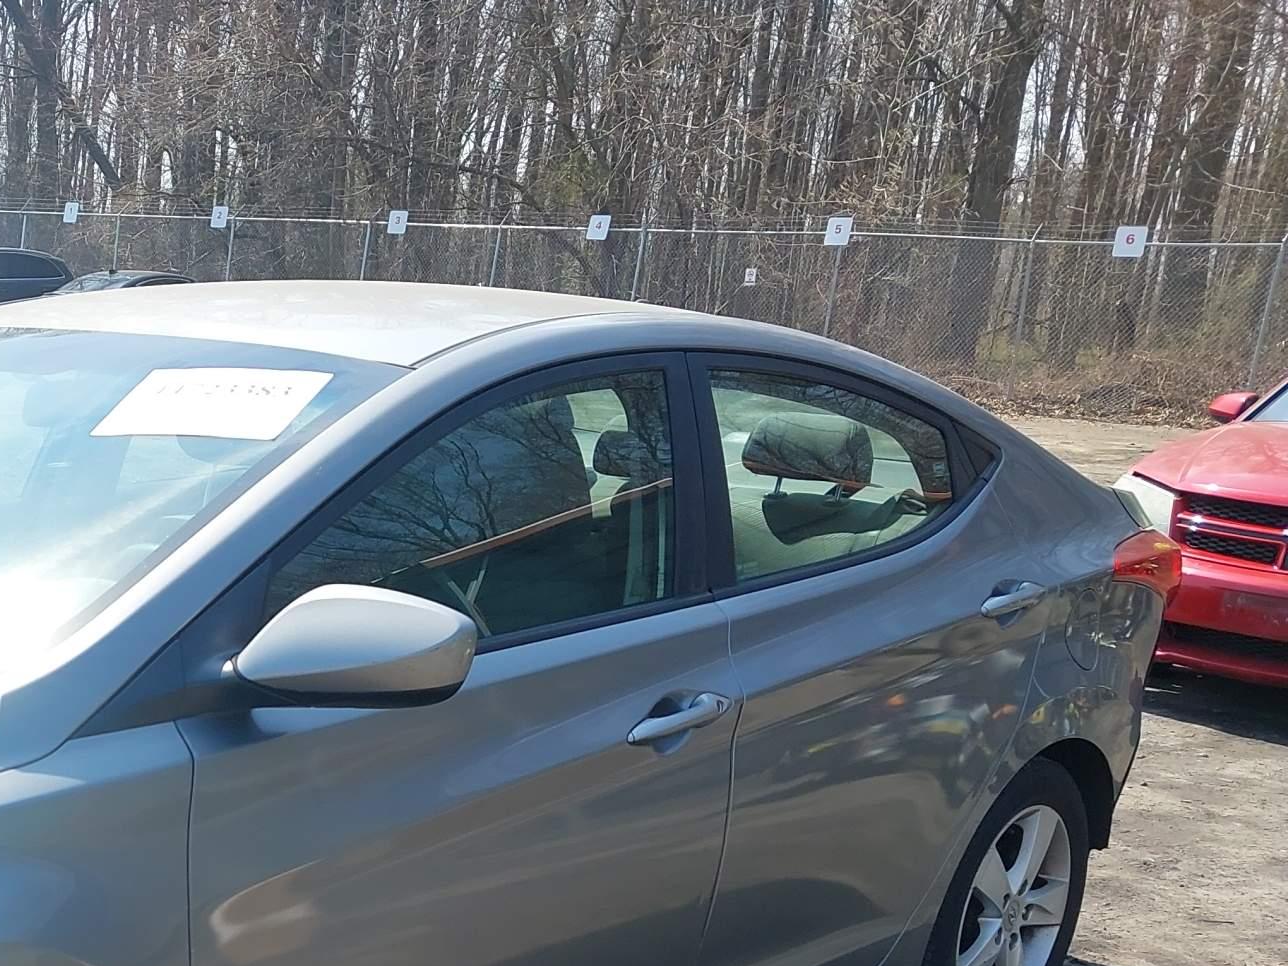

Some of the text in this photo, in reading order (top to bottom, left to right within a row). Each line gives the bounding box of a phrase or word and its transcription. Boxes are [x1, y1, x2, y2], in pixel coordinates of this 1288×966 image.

[394, 215, 401, 225] 3
[595, 220, 602, 230] 4
[834, 224, 844, 235] 5
[1126, 233, 1136, 245] 6
